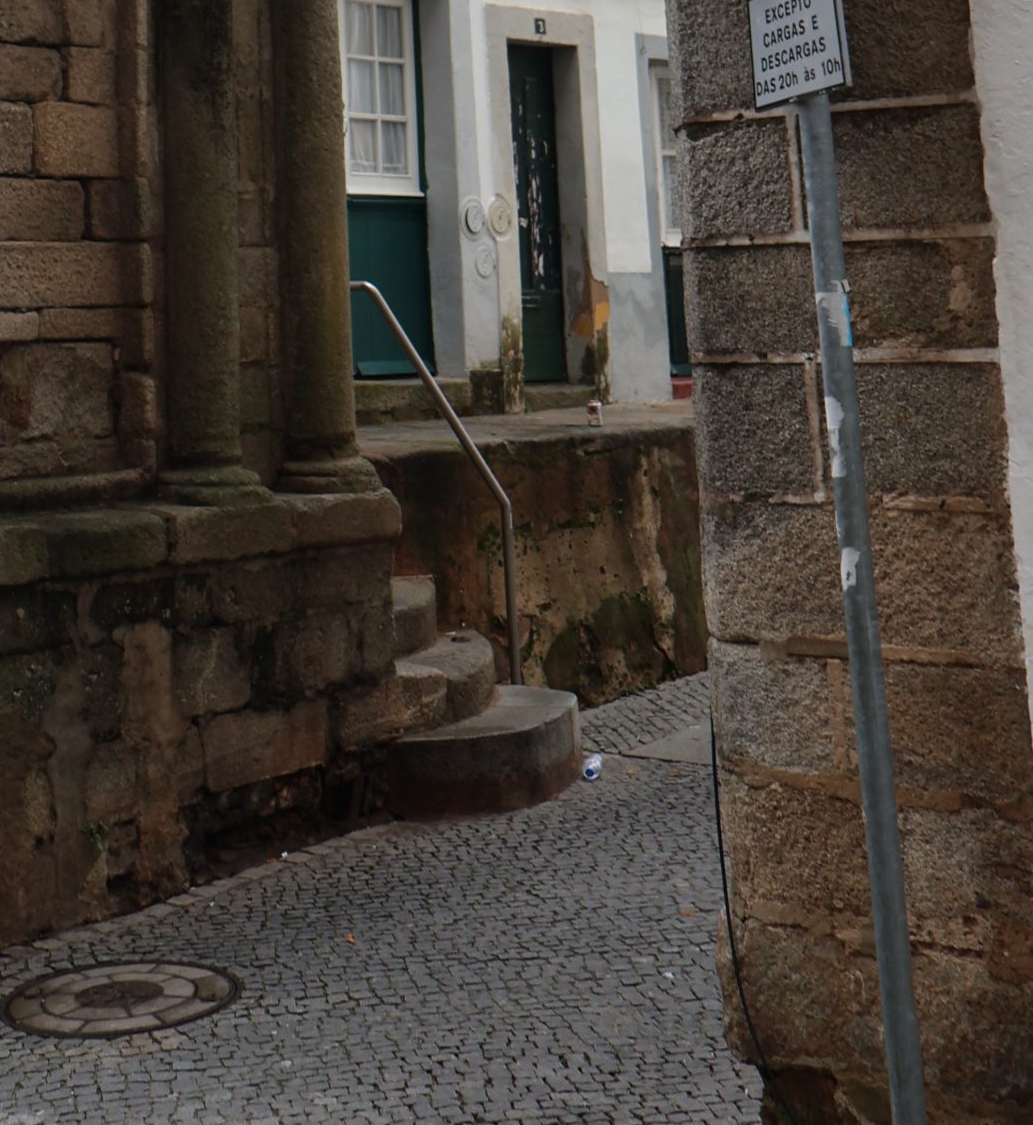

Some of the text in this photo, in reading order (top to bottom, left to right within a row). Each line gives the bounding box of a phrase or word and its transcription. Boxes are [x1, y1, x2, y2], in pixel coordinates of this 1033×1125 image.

[763, 14, 819, 48] CARGAS E
[761, 36, 826, 73] DESCARGAS
[756, 57, 841, 96] DAS 20h às 10h
